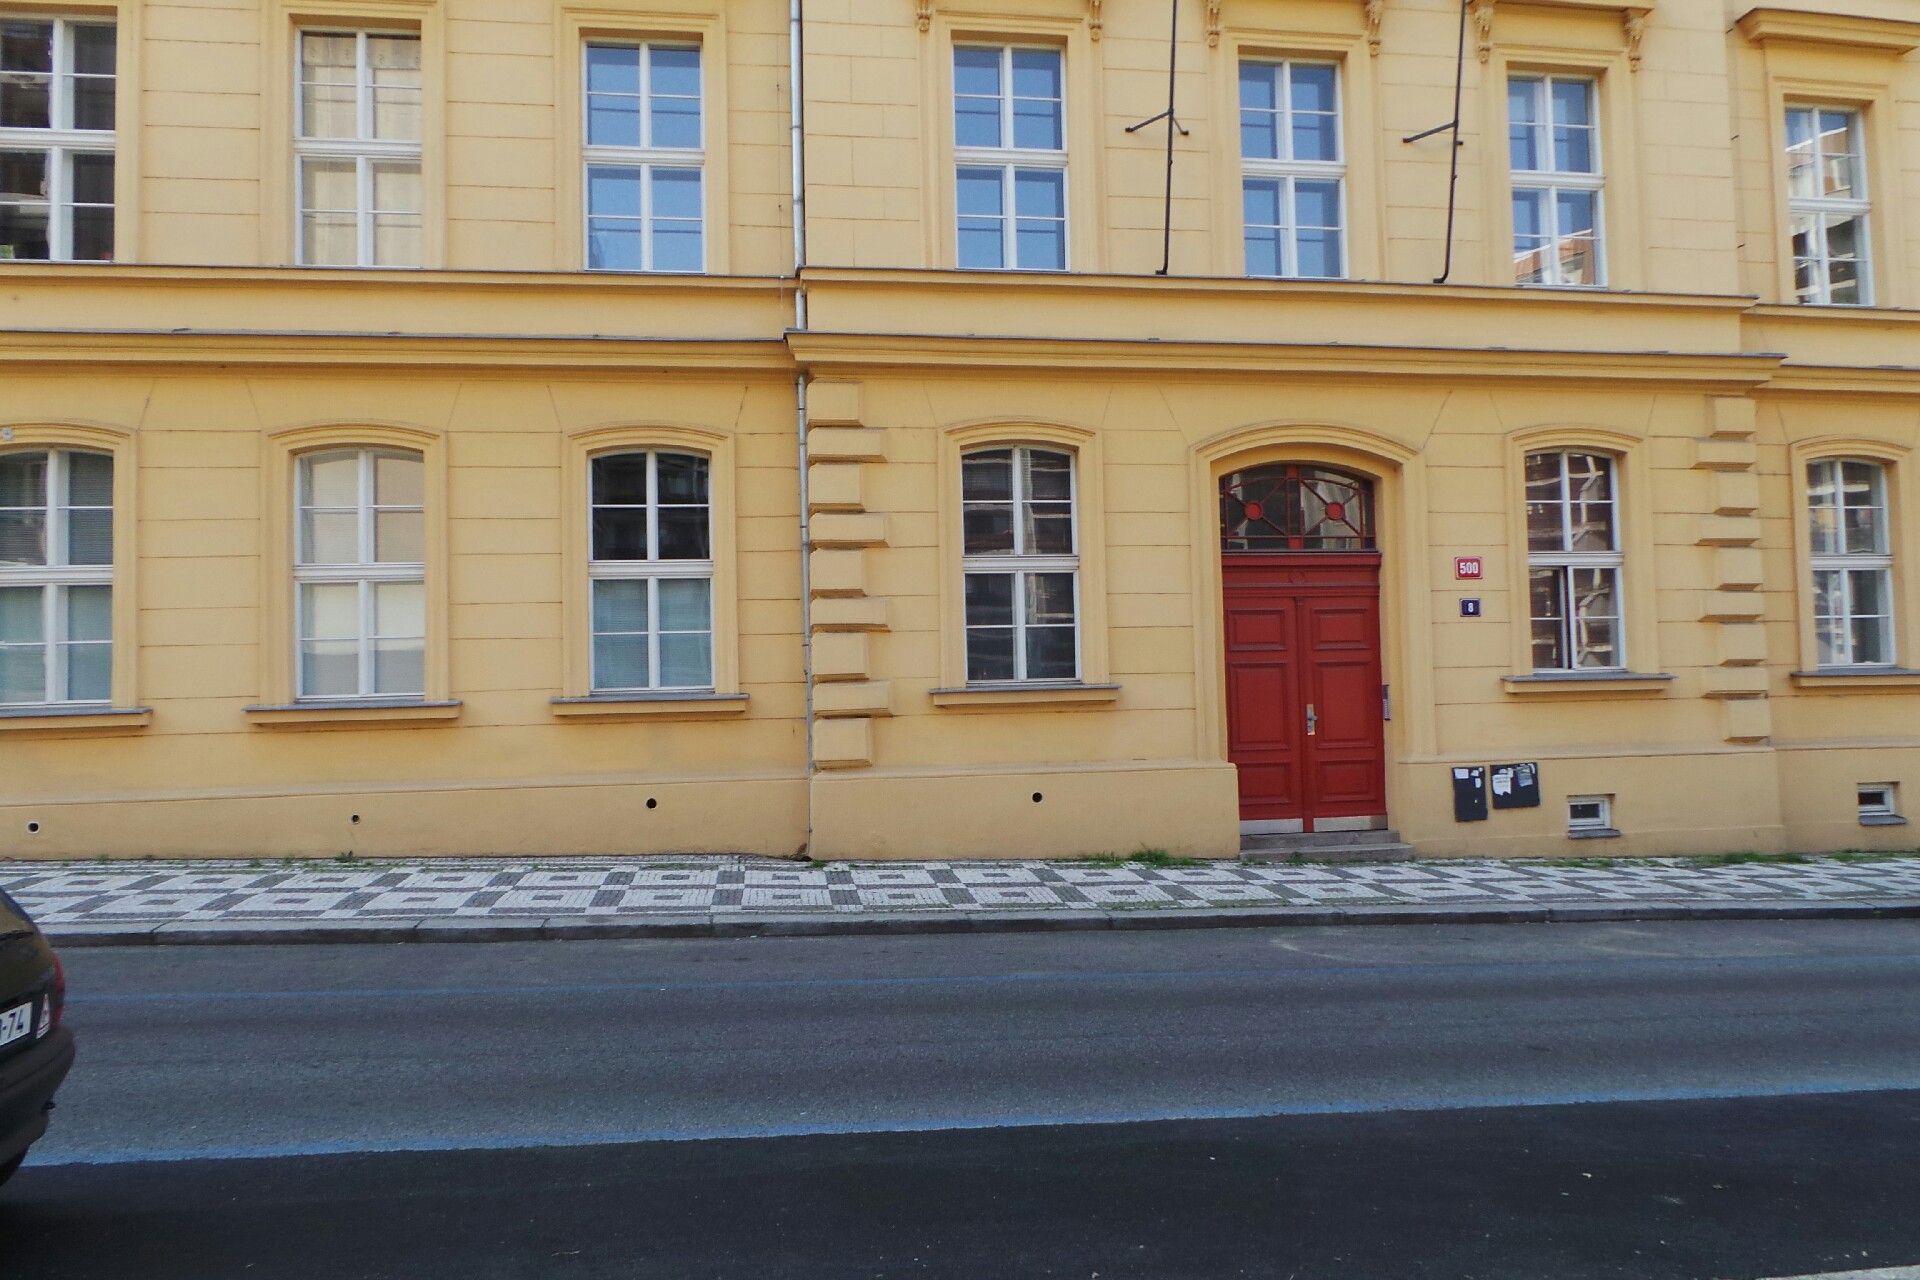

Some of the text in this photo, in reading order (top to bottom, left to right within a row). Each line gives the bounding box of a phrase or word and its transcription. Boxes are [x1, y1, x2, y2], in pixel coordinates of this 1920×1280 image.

[1459, 562, 1479, 574] 500
[1467, 602, 1474, 613] 8
[0, 1009, 24, 1040] -74
